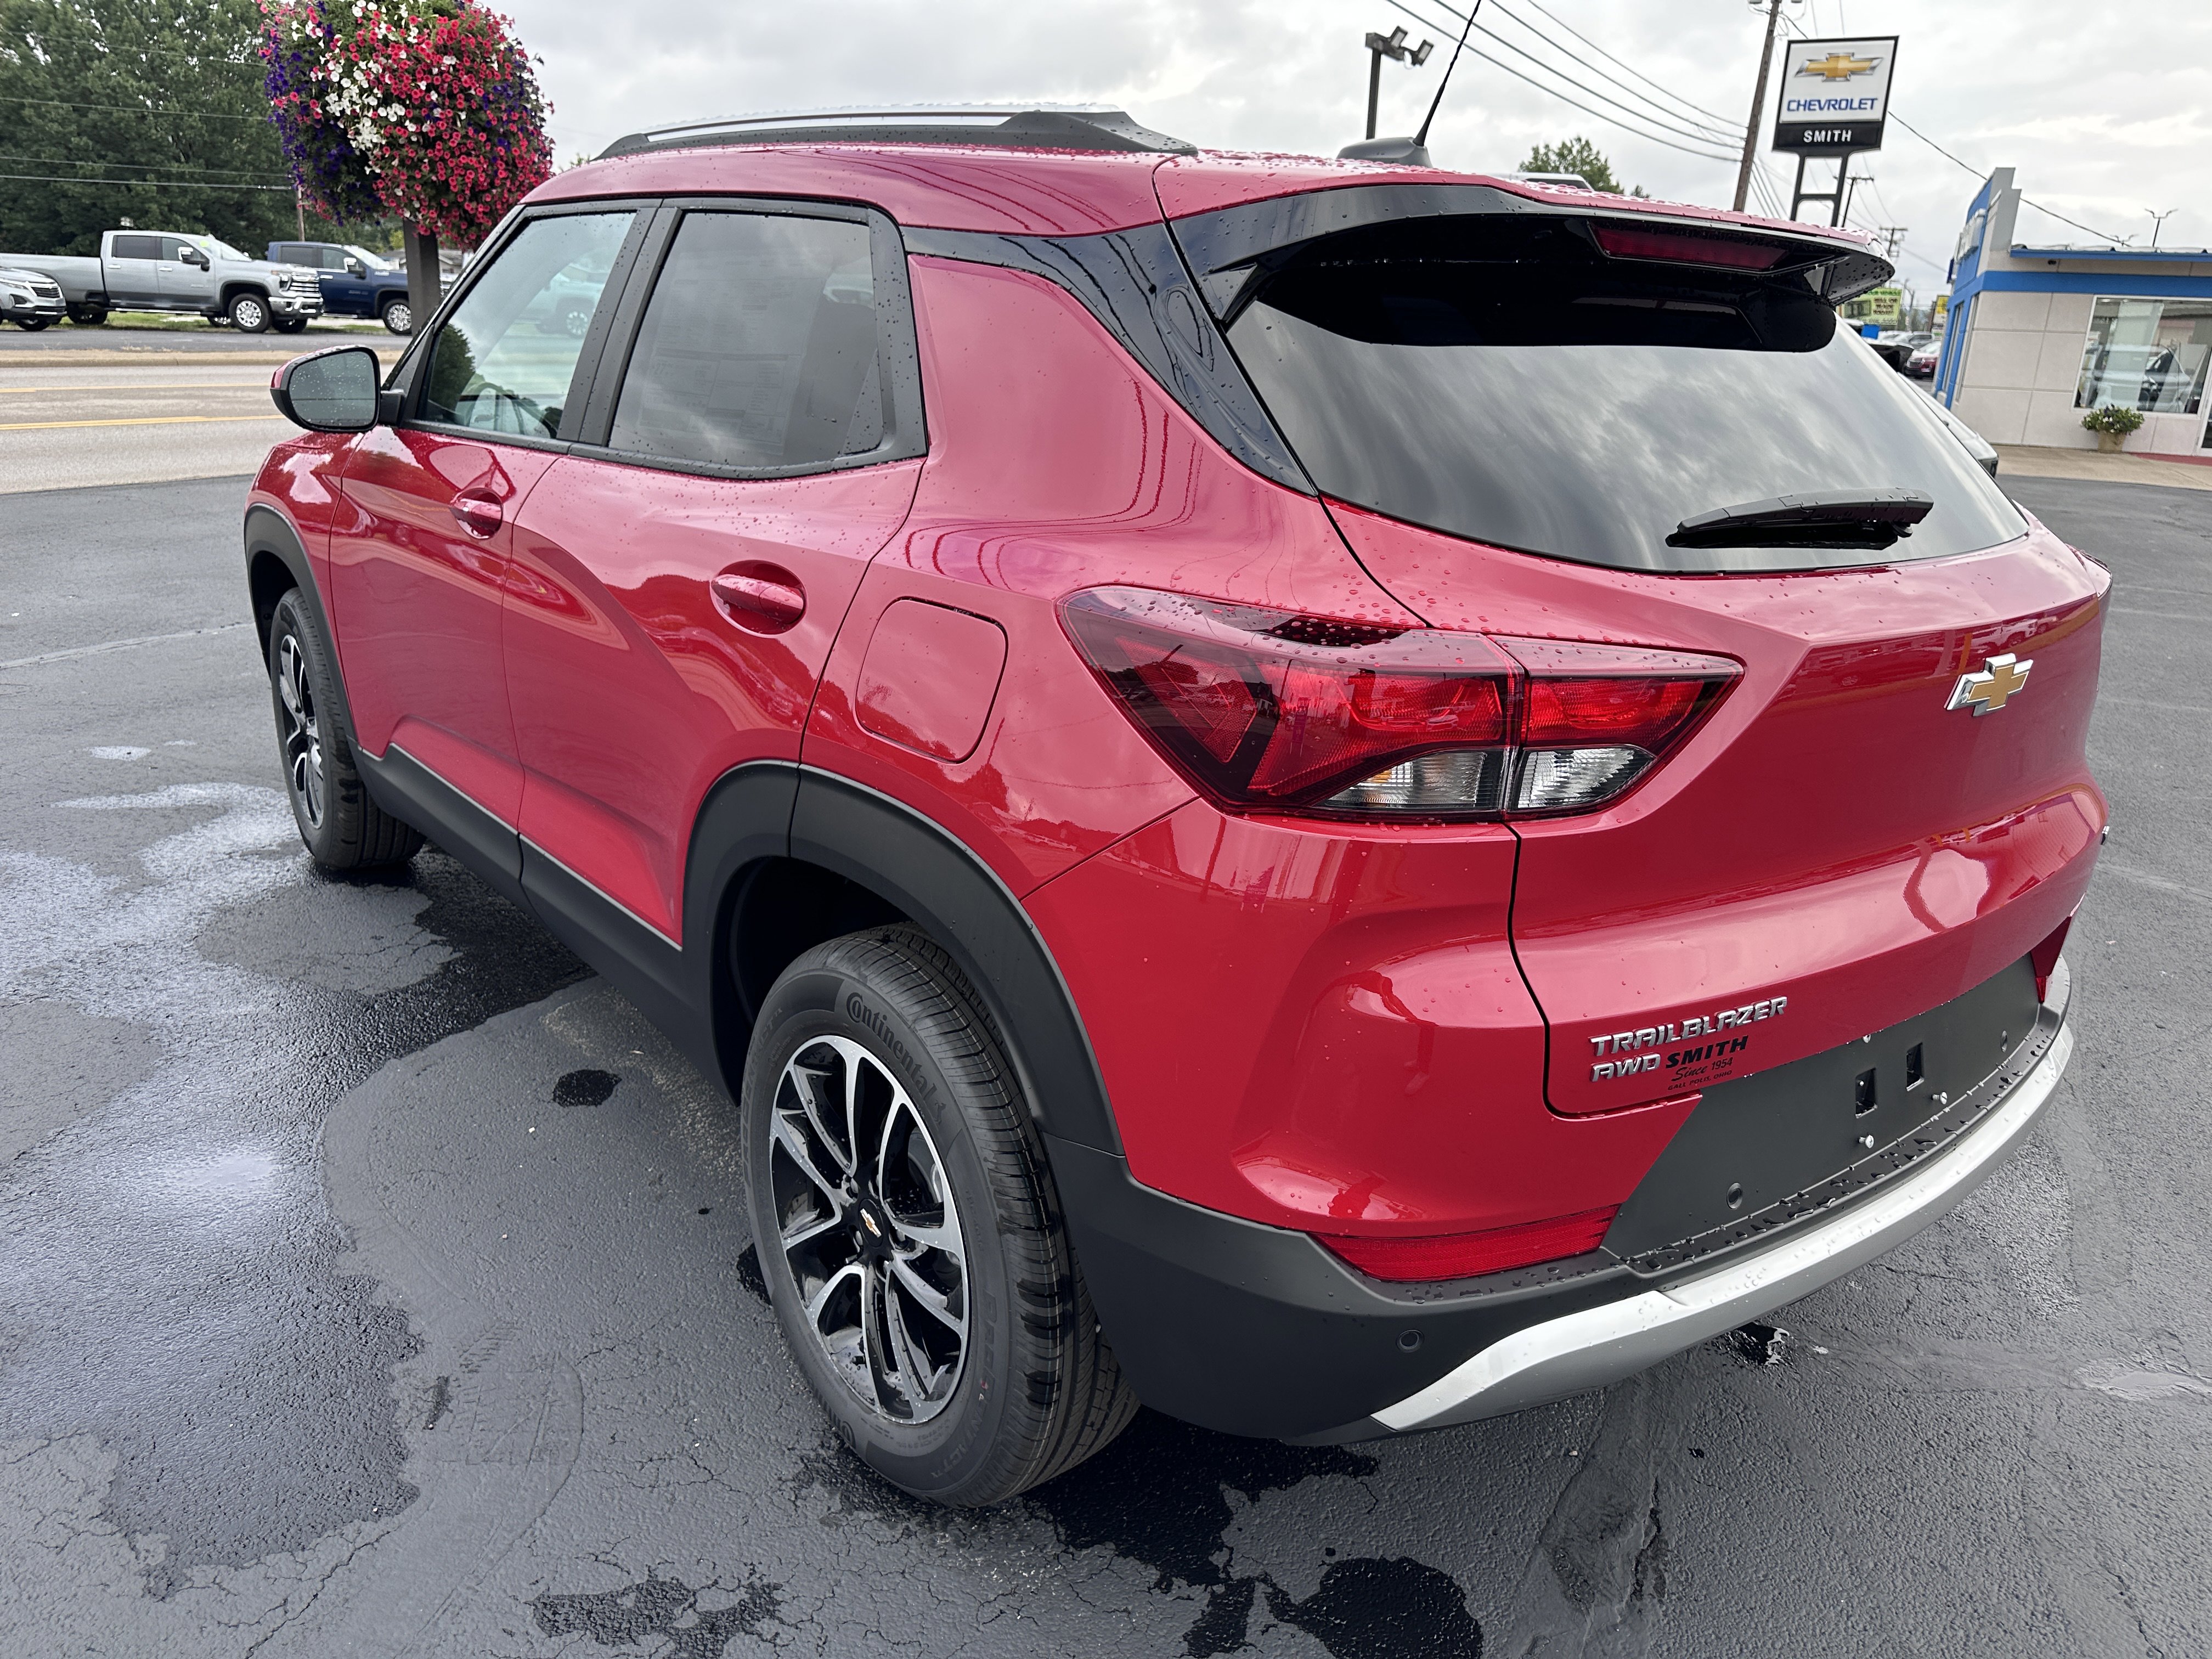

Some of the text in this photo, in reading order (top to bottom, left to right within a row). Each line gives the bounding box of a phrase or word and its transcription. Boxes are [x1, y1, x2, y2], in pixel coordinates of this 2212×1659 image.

[1787, 98, 1878, 112] CHEVROLET
[1803, 129, 1852, 143] SMITH
[1588, 996, 1787, 1056] TRAILBLAZER
[847, 992, 937, 1101] Continental
[1666, 1035, 1749, 1068] SMITH
[1590, 1052, 1661, 1082] AWD
[1672, 1057, 1734, 1081] Since 1954
[1713, 1070, 1733, 1079] OHIO
